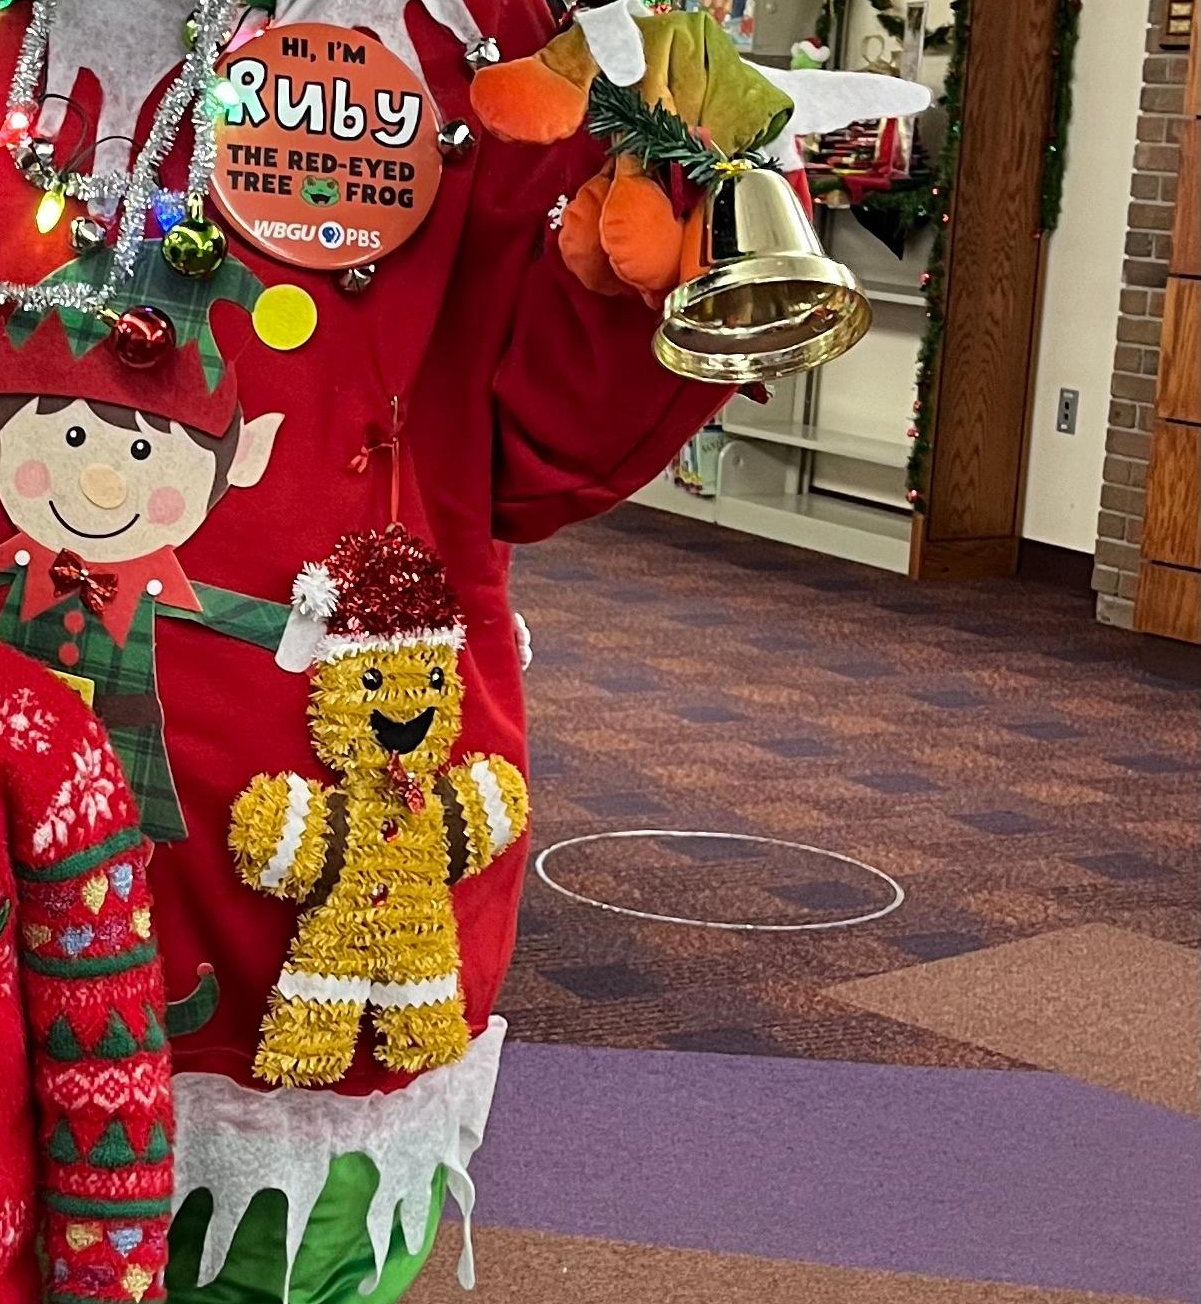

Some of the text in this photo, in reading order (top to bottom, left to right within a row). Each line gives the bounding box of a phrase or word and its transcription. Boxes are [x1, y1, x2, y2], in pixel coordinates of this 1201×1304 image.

[281, 37, 366, 64] HI, I'M
[226, 58, 422, 148] Ruby
[227, 144, 415, 182] THE RED-EYED
[227, 170, 414, 209] TREE FROG
[252, 220, 382, 249] WBGU PBS
